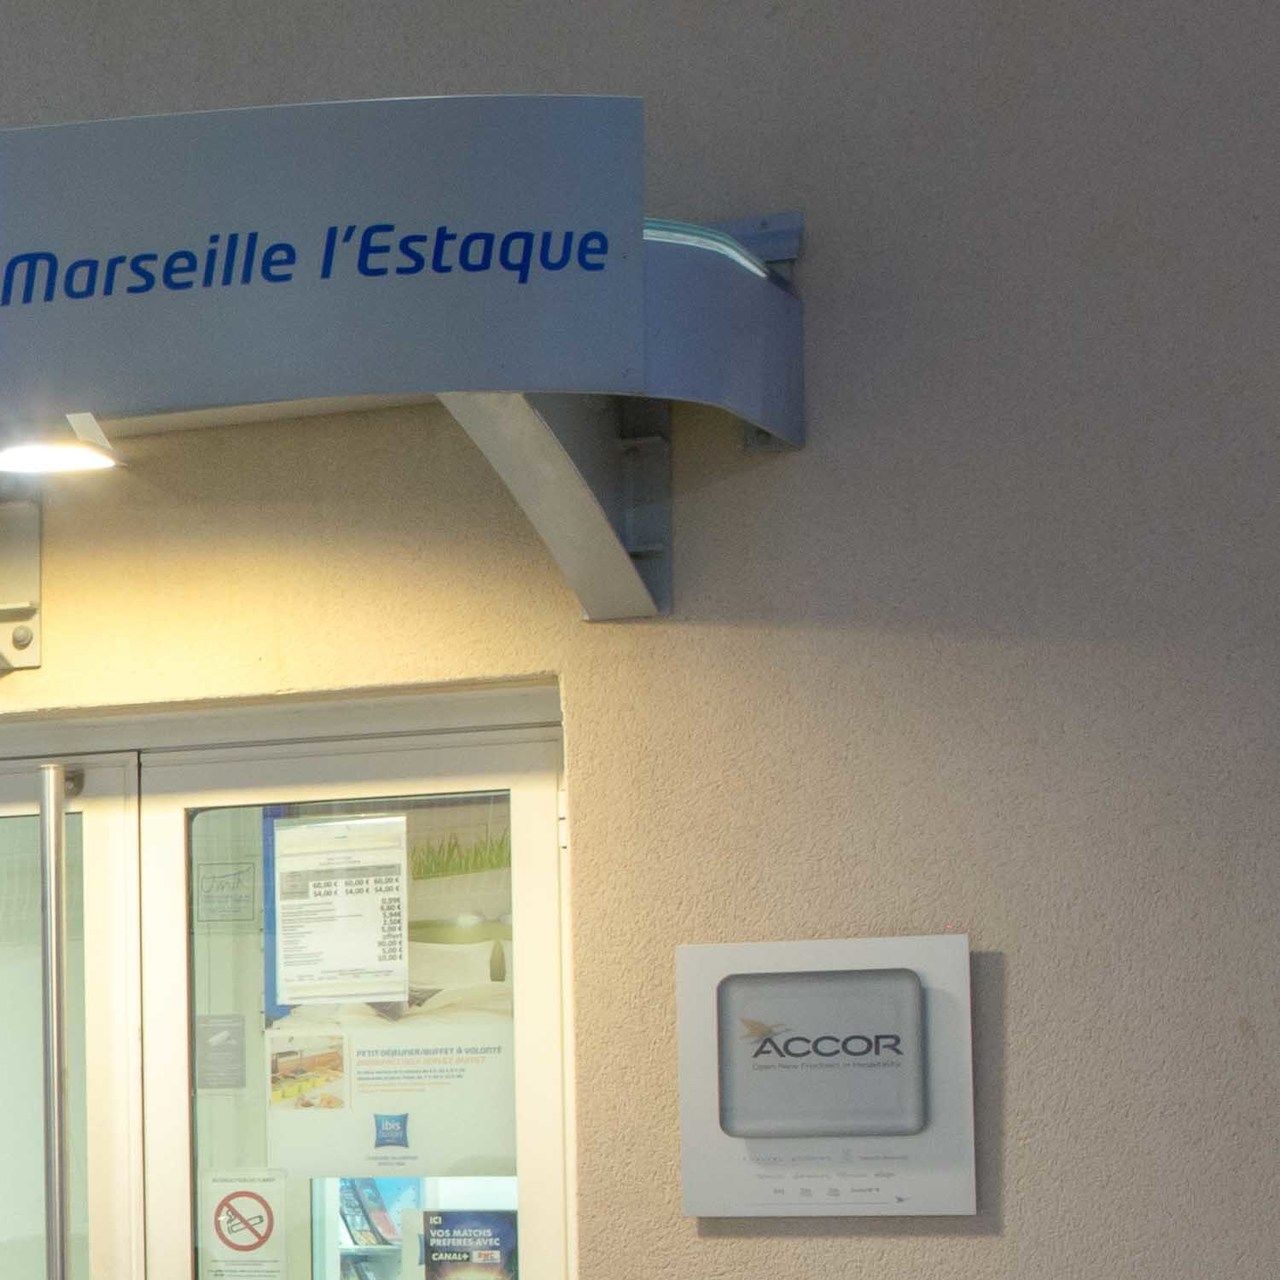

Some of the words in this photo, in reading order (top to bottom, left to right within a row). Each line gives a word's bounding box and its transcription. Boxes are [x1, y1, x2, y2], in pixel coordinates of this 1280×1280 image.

[0, 231, 297, 307] Marseille
[321, 223, 610, 284] l'Estaque
[752, 1034, 904, 1059] ACCOR
[429, 1216, 442, 1225] ICI
[429, 1229, 451, 1238] VOS
[452, 1228, 493, 1238] MATCHS
[431, 1252, 470, 1261] CANAL+
